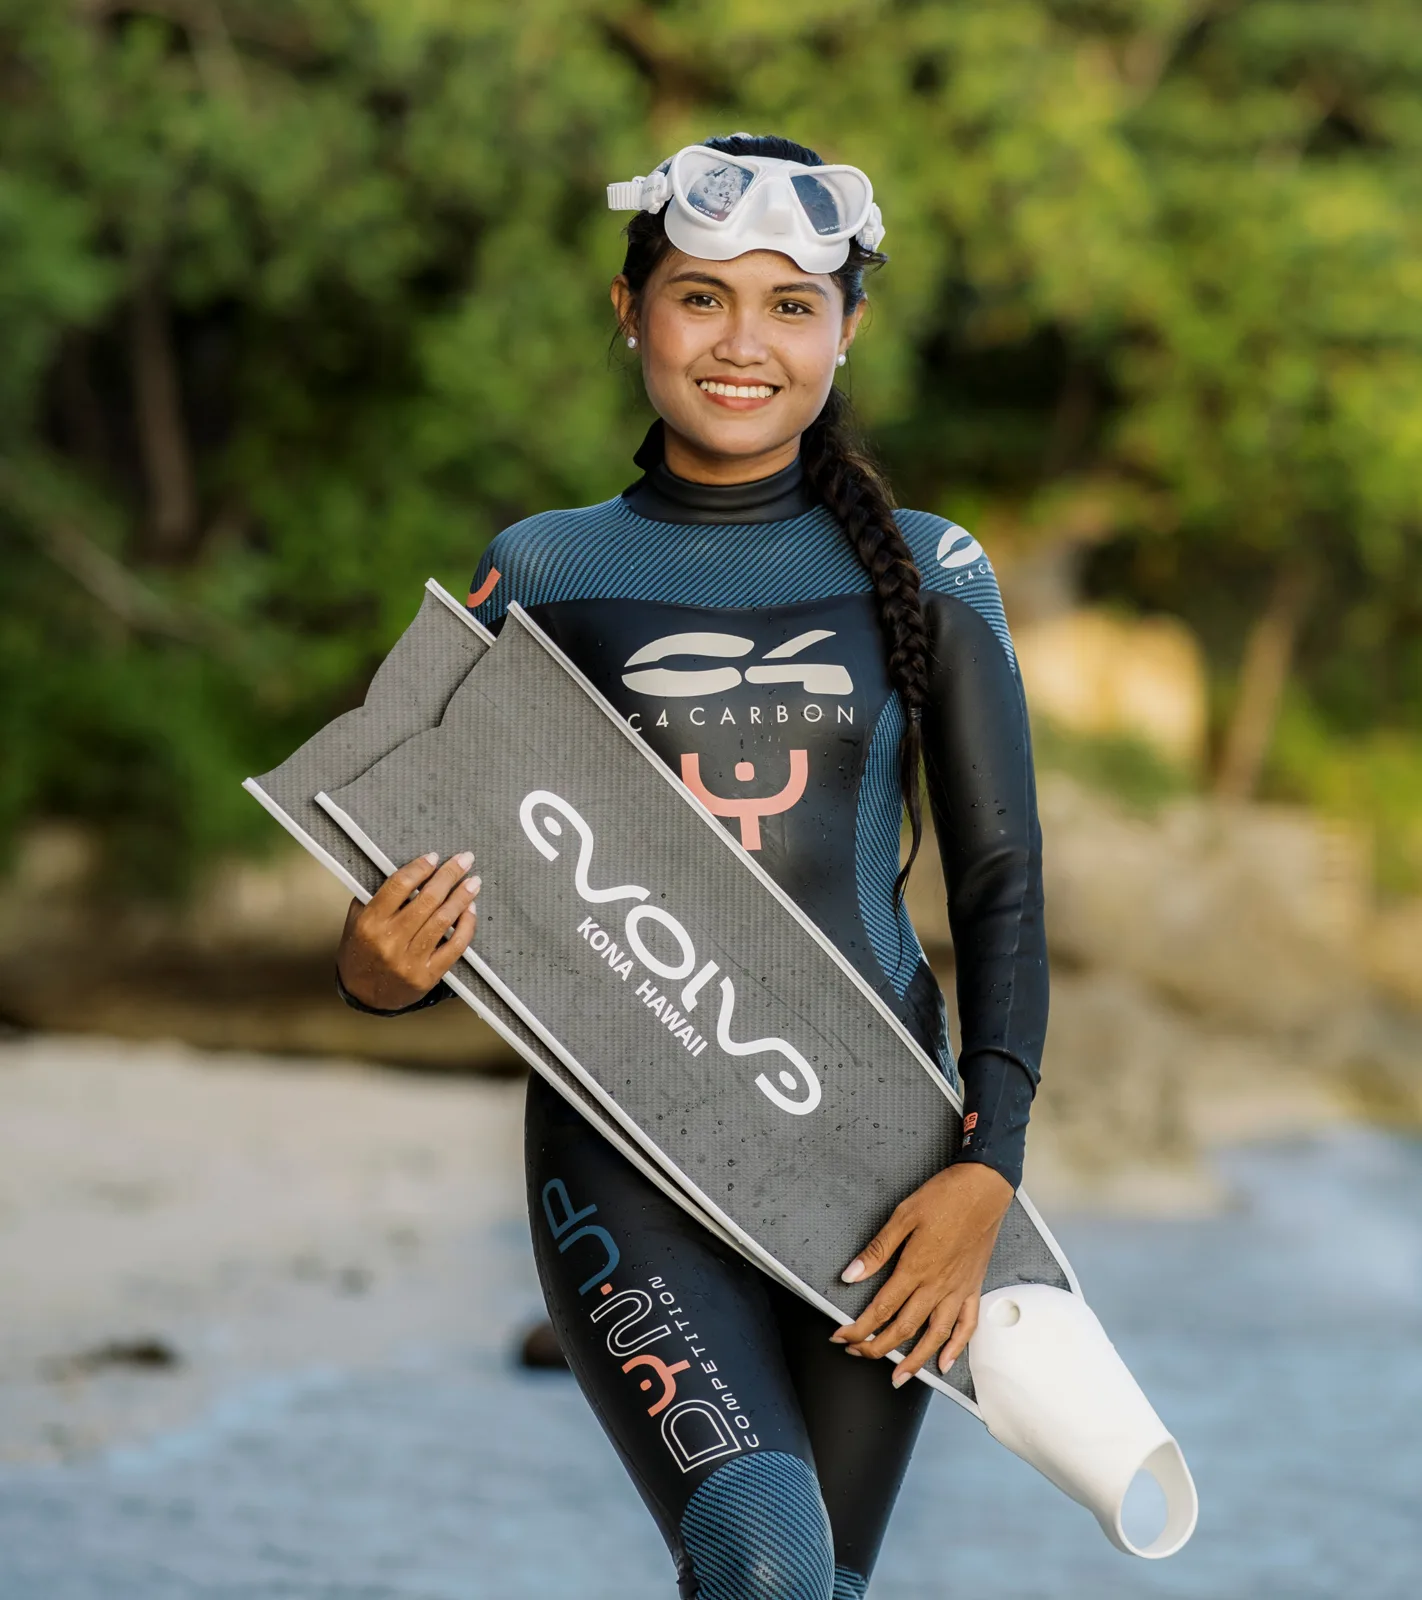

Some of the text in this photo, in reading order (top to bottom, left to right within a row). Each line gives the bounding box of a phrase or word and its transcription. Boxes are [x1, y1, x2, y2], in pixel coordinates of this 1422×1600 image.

[576, 916, 708, 1057] KONA HAWAII
[648, 1276, 760, 1448] COMPETITION
